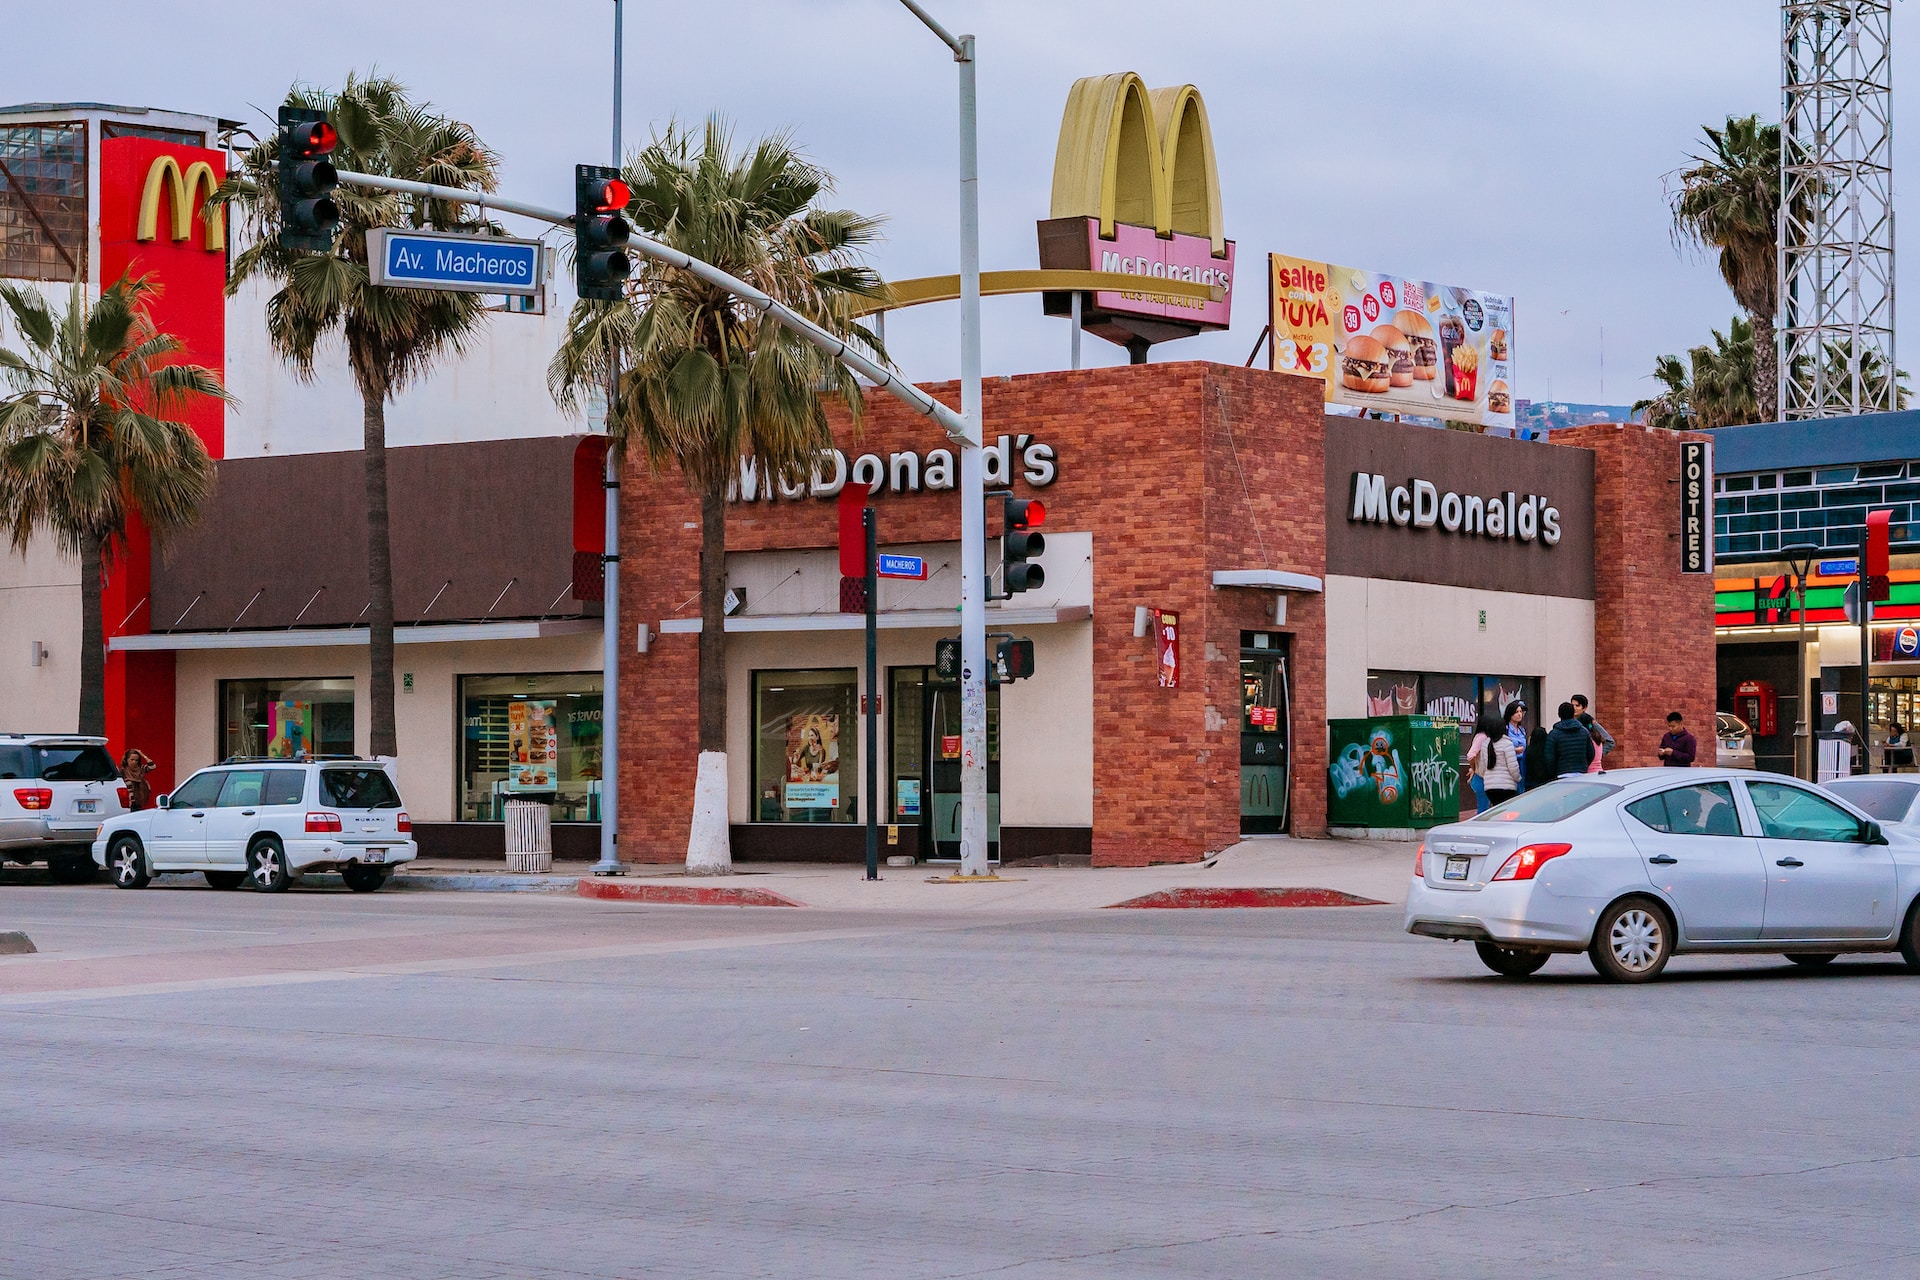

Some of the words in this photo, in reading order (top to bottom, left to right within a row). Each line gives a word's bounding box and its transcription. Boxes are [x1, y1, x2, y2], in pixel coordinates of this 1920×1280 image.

[395, 246, 424, 270] Av.
[436, 249, 527, 277] Macheros
[1280, 265, 1325, 293] salte
[1280, 298, 1329, 328] TUYA
[726, 433, 1056, 501] McDonad's
[1350, 471, 1562, 546] McDonald's
[1687, 445, 1700, 570] POSTRES
[885, 559, 916, 570] MACHEROS
